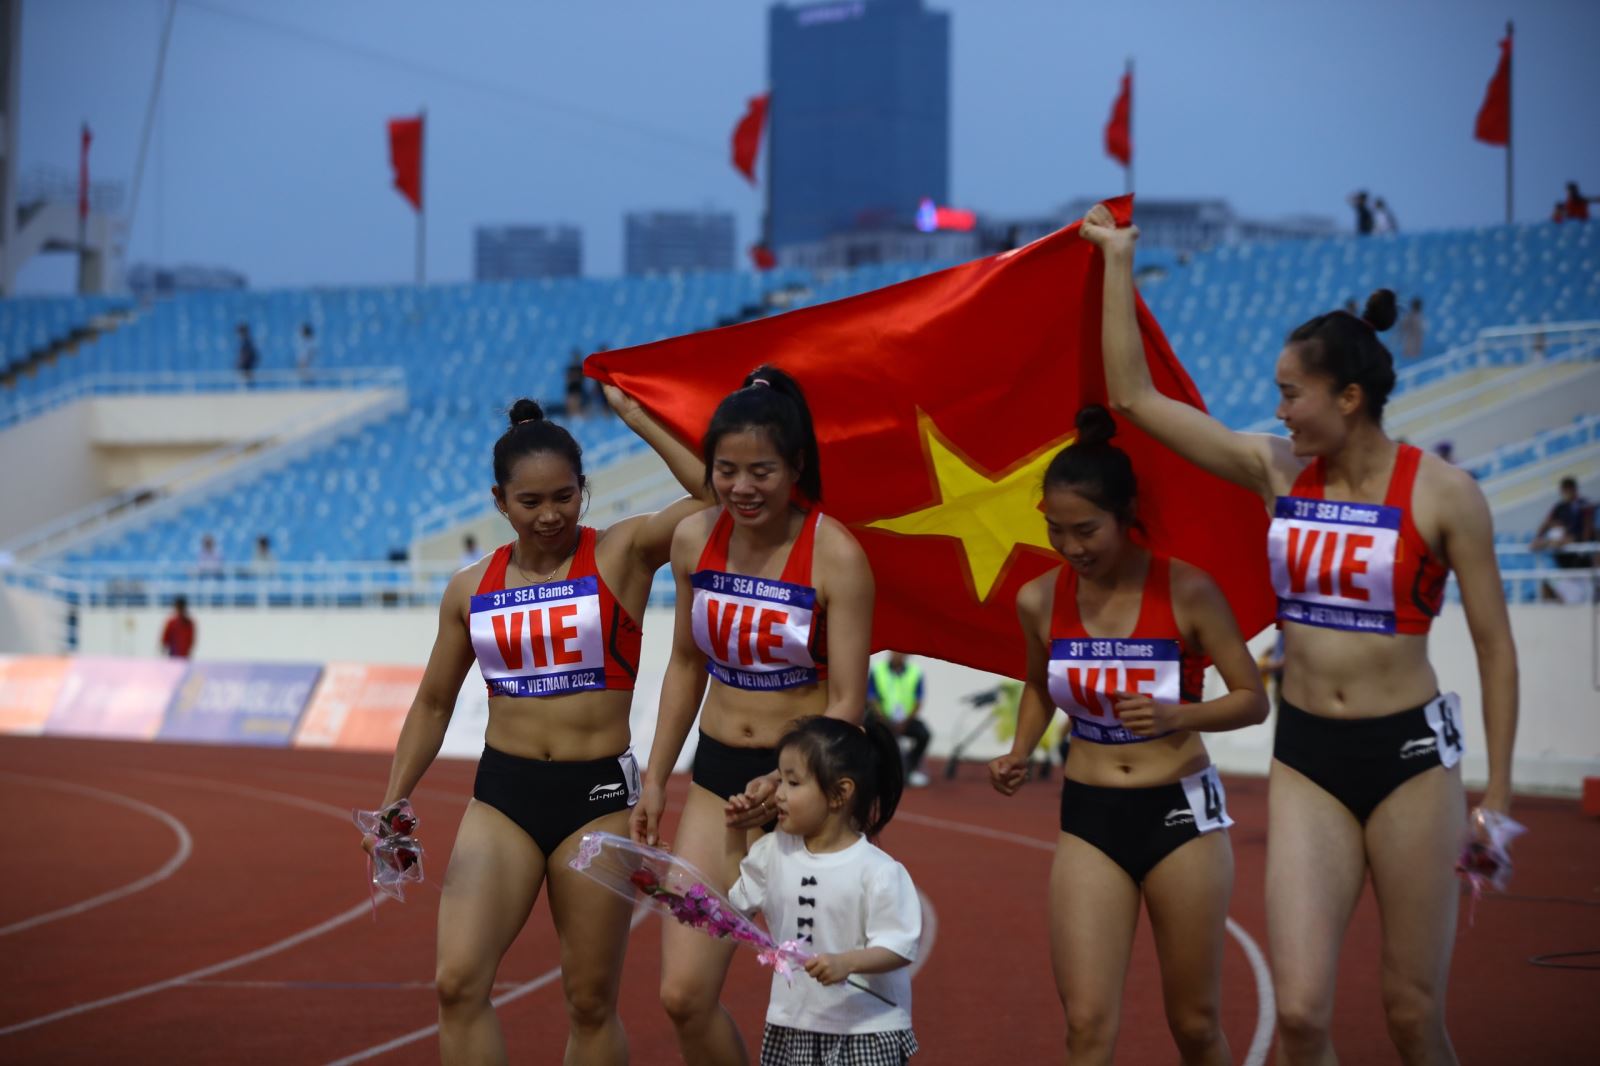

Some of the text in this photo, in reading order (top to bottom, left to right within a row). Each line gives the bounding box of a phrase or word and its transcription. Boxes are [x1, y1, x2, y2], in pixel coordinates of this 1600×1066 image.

[1287, 527, 1375, 602] VIE
[515, 589, 535, 603] SEA
[539, 584, 574, 600] Games
[733, 578, 753, 595] SEA
[756, 582, 791, 601] Games
[491, 604, 583, 670] VIE
[707, 598, 789, 666] VIE
[1091, 642, 1113, 657] SEA
[1115, 642, 1154, 657] Games
[527, 676, 569, 693] VIETNAM
[571, 672, 595, 688] 2022
[736, 671, 781, 688] VIETNAM
[783, 669, 809, 685] 2022
[1438, 700, 1463, 752] 4
[589, 789, 625, 801] LI-NING
[1201, 774, 1224, 824] 4
